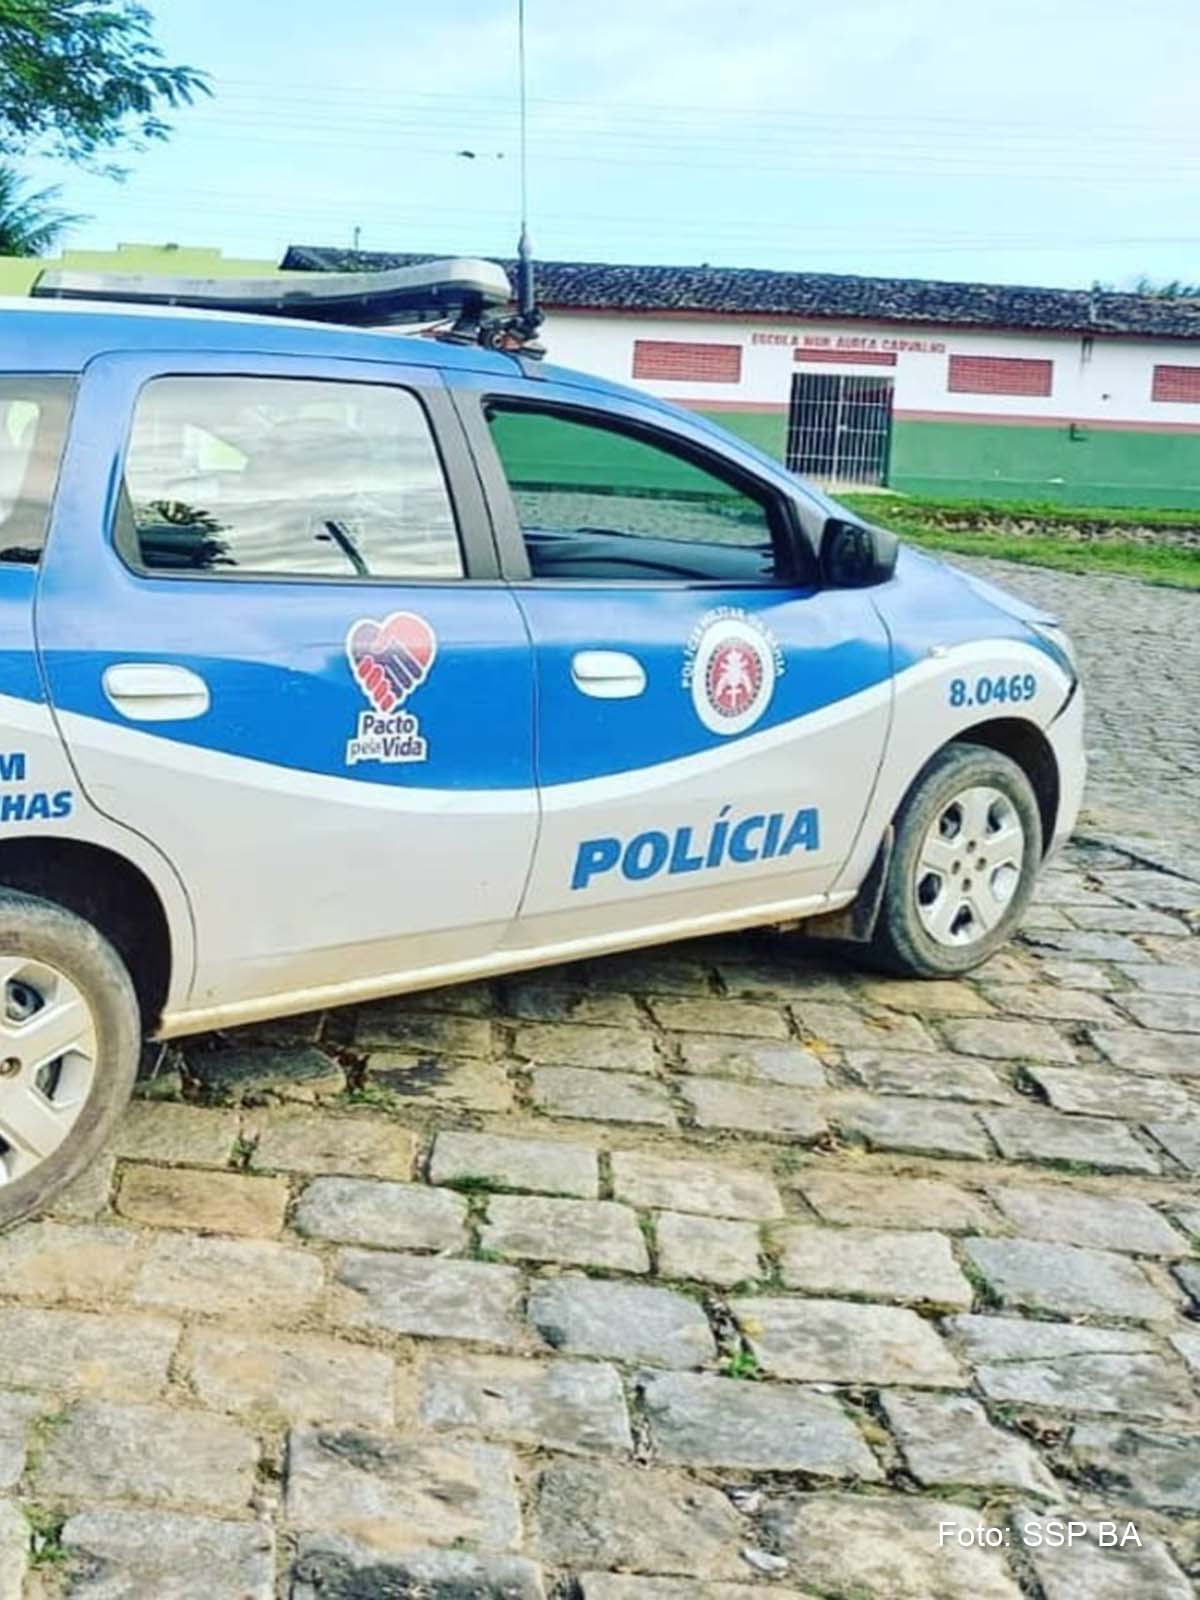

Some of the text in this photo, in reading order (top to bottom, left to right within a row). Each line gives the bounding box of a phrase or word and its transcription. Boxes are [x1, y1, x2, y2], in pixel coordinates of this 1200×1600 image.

[751, 332, 799, 346] ESCOLA
[950, 674, 1036, 707] 8.0469
[363, 714, 414, 735] Pacto
[382, 736, 423, 757] Vida
[570, 804, 821, 891] POLÍCIA
